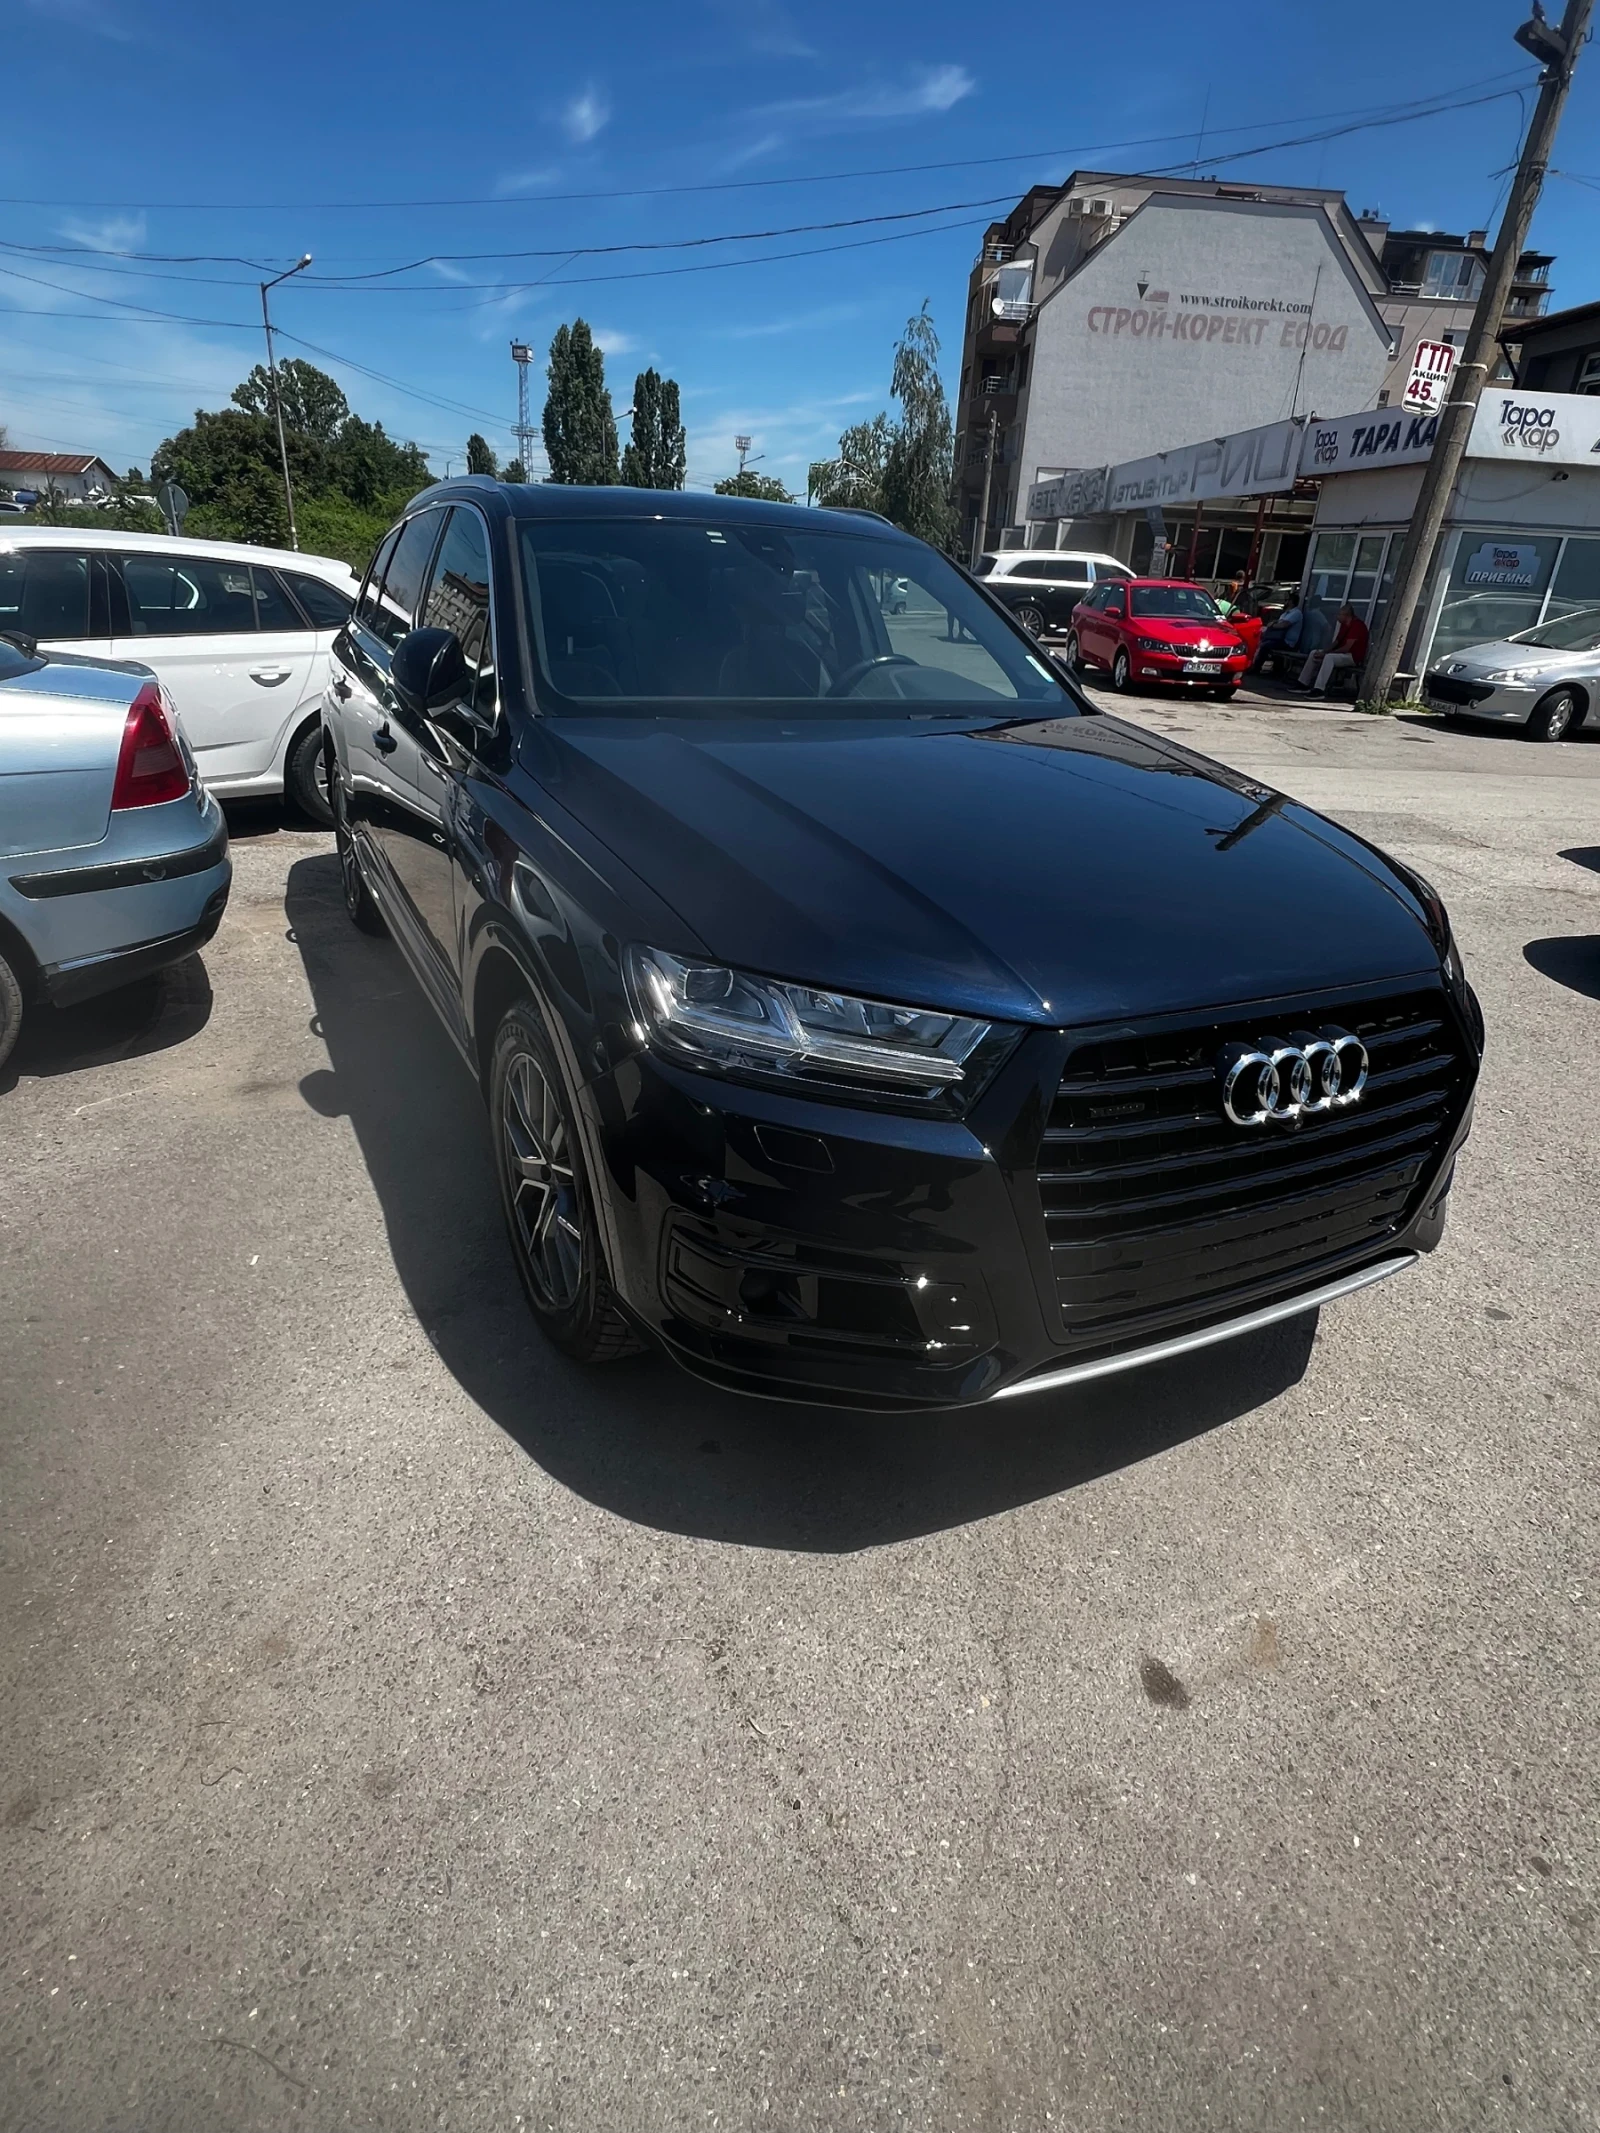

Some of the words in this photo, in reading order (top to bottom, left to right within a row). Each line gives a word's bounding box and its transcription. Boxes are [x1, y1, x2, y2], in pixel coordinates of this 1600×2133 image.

[1179, 293, 1312, 315] www.stroikorekt.com
[1087, 306, 1269, 346] СТРОЙ-КОРЕКТ
[1414, 341, 1454, 374] ГТП
[1412, 370, 1448, 382] АКЦИЯ
[1407, 379, 1433, 401] 45
[1349, 421, 1402, 458] ТАРА
[1402, 414, 1438, 450] КА
[1469, 571, 1533, 586] ПРИЕМНА
